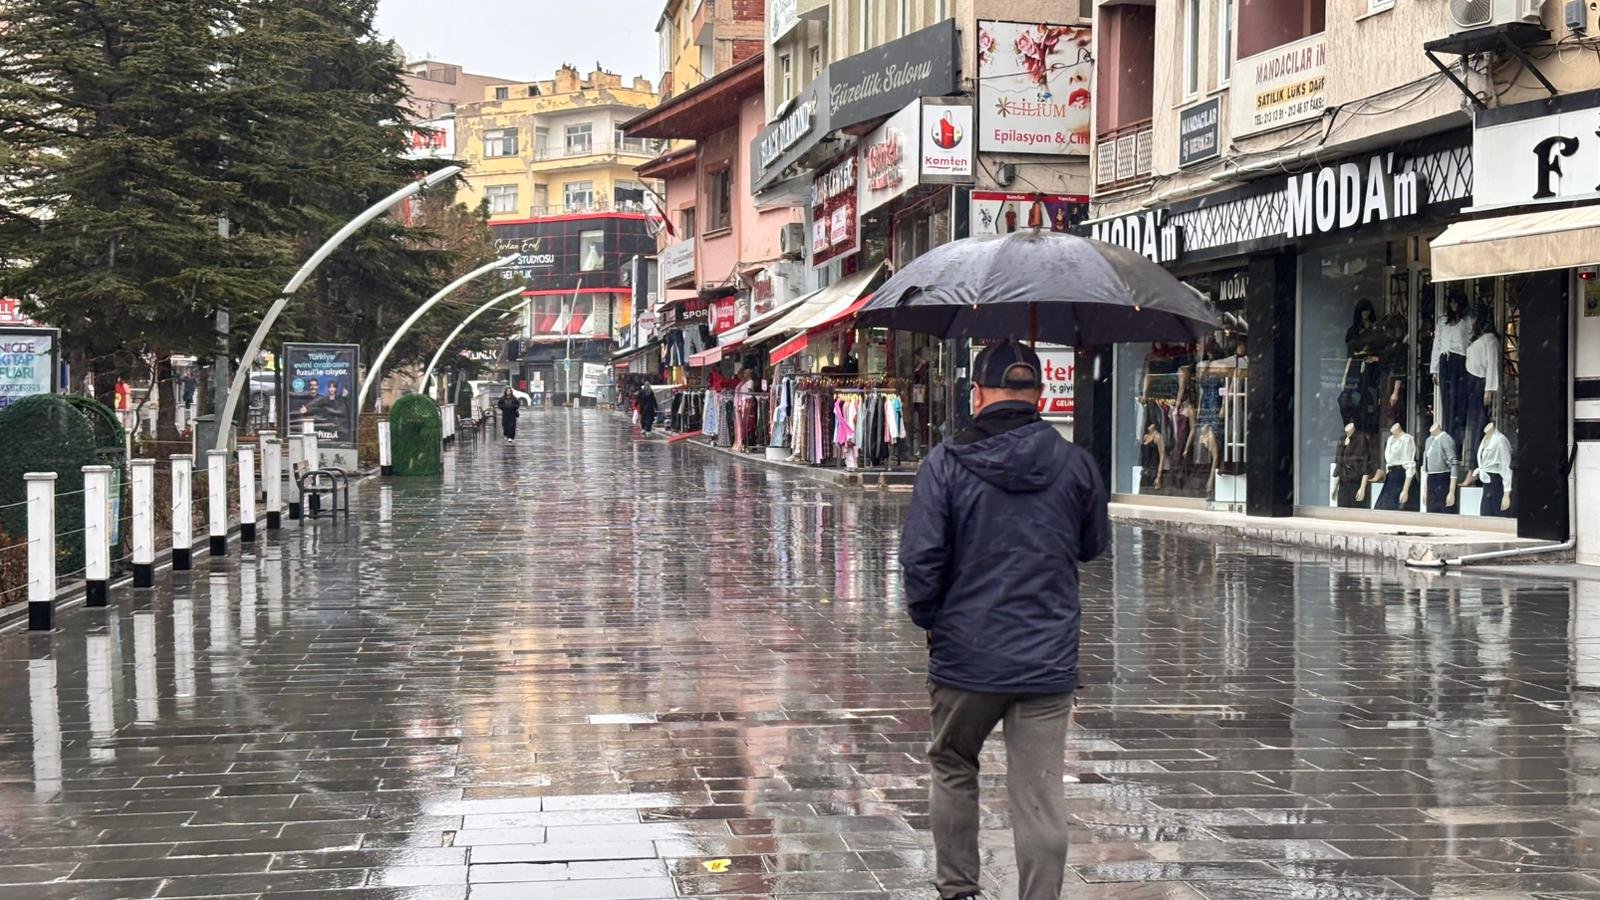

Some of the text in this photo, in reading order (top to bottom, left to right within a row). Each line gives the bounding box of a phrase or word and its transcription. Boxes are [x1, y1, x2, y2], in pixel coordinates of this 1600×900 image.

[1255, 48, 1312, 85] MANDACILAR
[830, 60, 932, 116] Güzellik Salonu
[1257, 91, 1284, 108] SATILIK
[1287, 83, 1306, 98] LÜKS
[994, 129, 1051, 145] Epilasyon
[1055, 132, 1065, 144] &
[925, 156, 968, 166] Komten
[1286, 151, 1417, 239] MODA'm
[682, 308, 709, 320] SPOR
[308, 352, 335, 361] Türkiye
